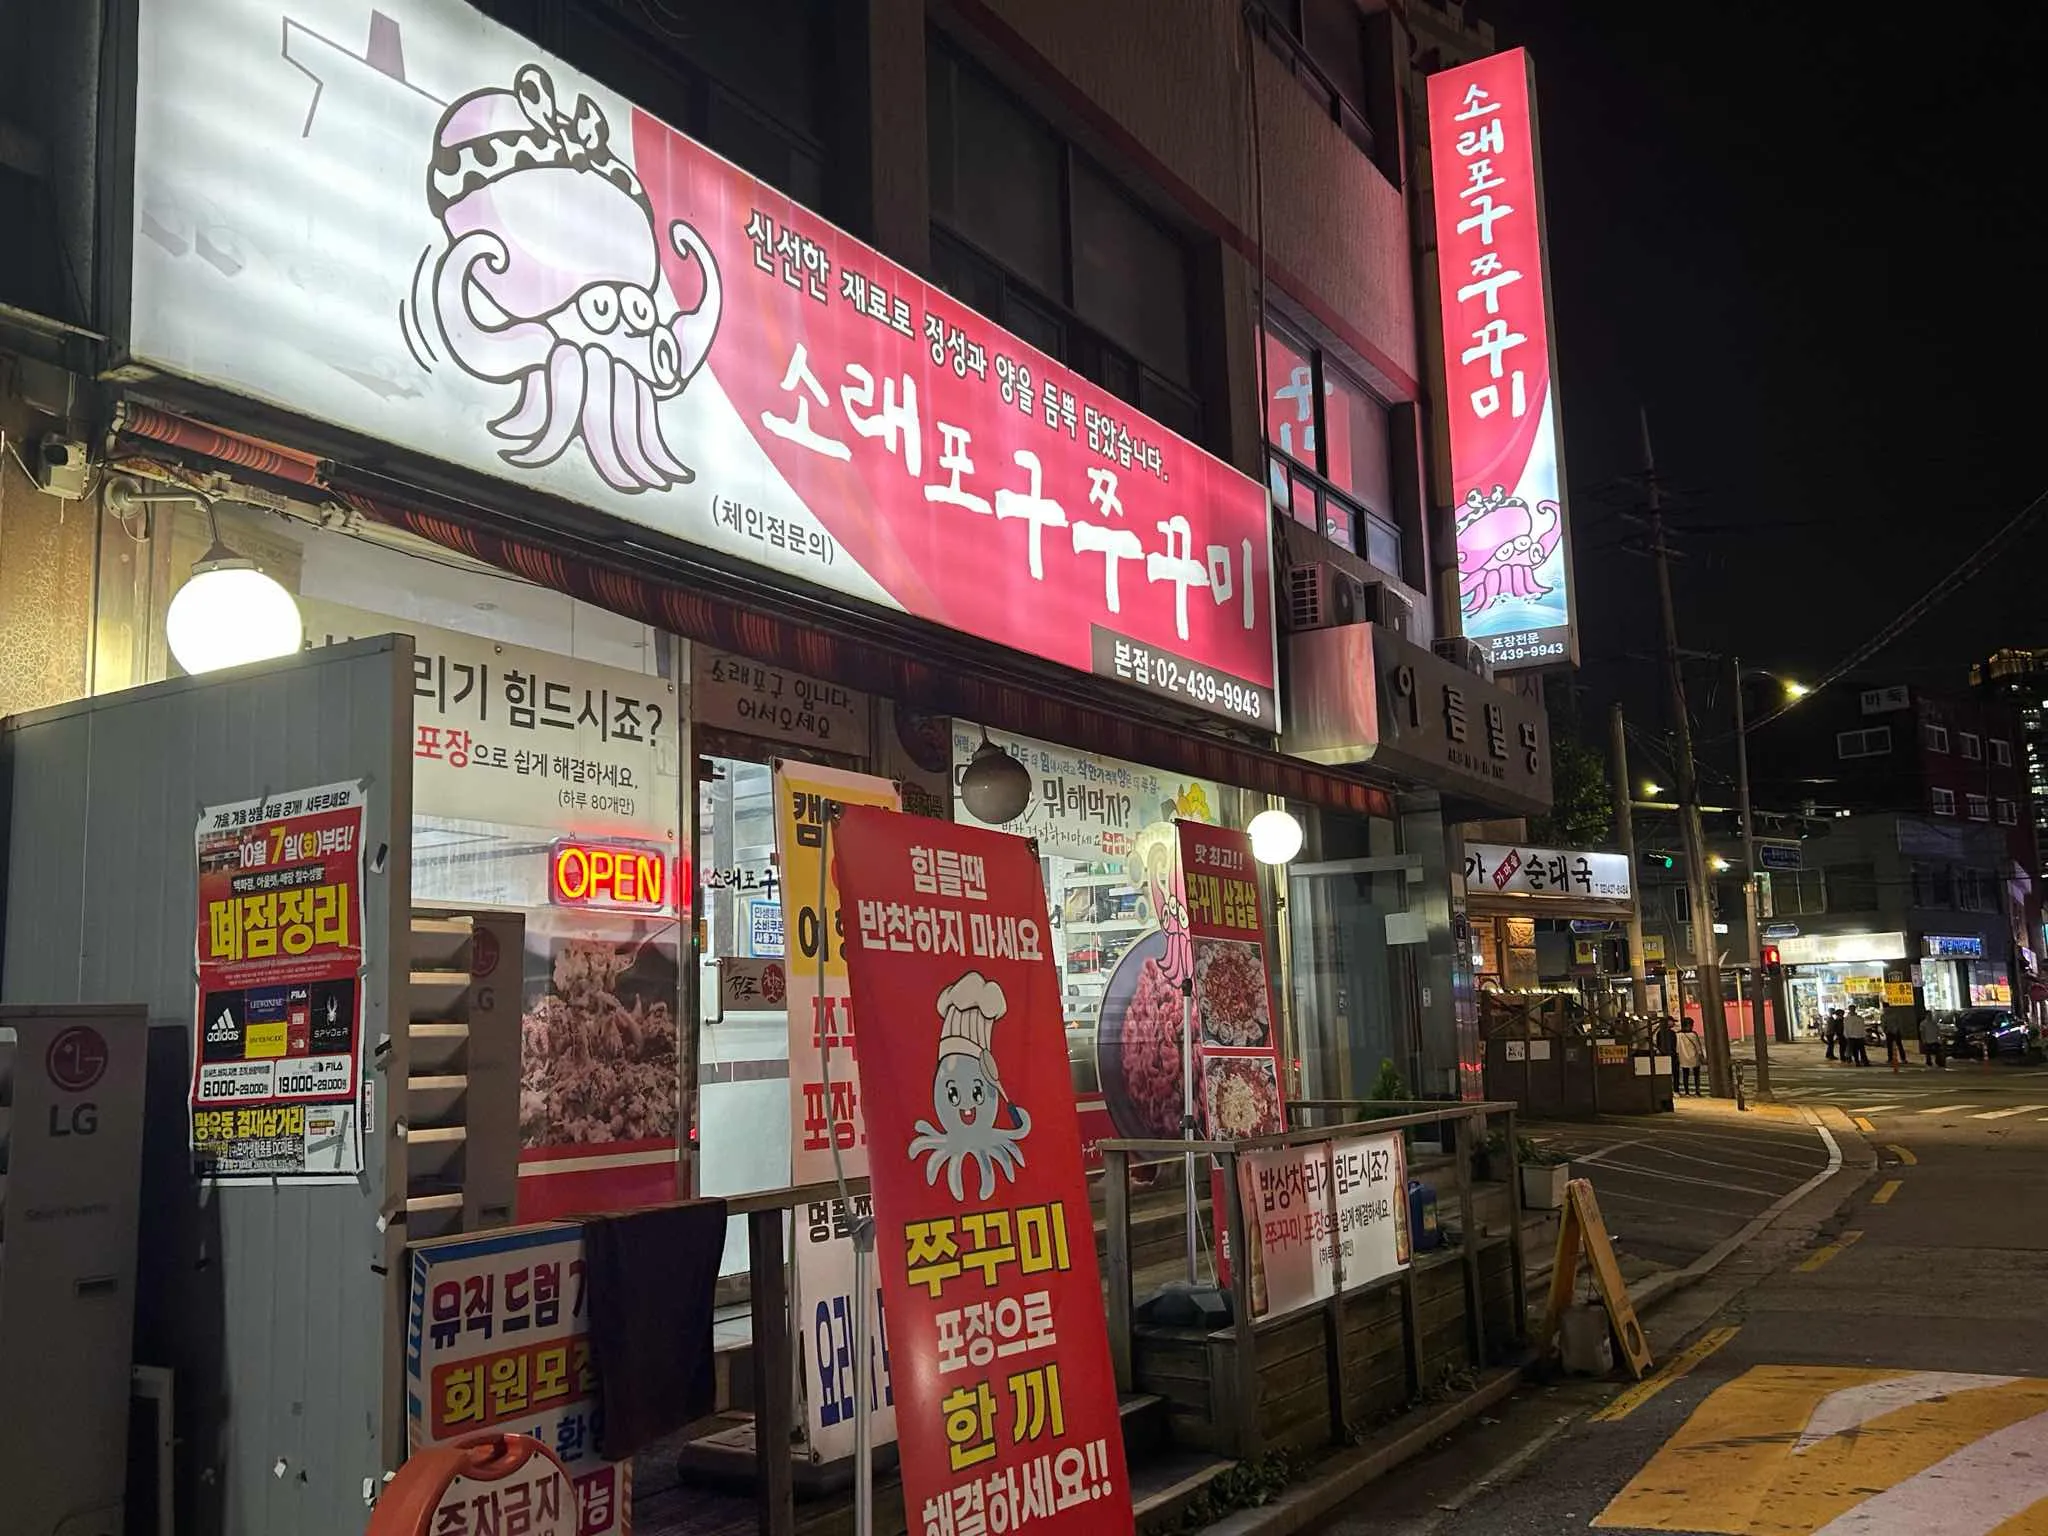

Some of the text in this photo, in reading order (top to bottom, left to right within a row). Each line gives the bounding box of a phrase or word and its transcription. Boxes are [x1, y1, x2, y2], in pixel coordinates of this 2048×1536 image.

[745, 209, 1169, 482] 신선한 재료로 정성과 양을 듬뿍 담았습니다.
[711, 494, 834, 566] (체인점문의)
[1491, 632, 1540, 649] 포장전문
[504, 669, 663, 747] 힘드시죠?
[711, 658, 854, 714] 소래포구 입니다.
[1113, 639, 1261, 721] 본점:02-439-9943
[737, 698, 831, 739] 어서오세요
[415, 725, 639, 790] 포장으로 쉽게 해결하세요.
[558, 789, 635, 817] (하루 80개만)
[793, 792, 824, 848] 캠
[1042, 777, 1131, 829] 뭐해먹지?
[239, 840, 267, 868] 10월
[558, 847, 662, 903] OPEN
[909, 845, 988, 901] 힘들땐
[1523, 853, 1593, 894] 순대국
[708, 867, 778, 901] 소래포구
[1186, 872, 1259, 931] 쭈꾸미 삼겹살
[209, 883, 349, 961] 폐점정리
[858, 899, 1043, 961] 반찬하지 마세요
[207, 1029, 239, 1042] adidas
[50, 1102, 97, 1138] LG
[194, 1110, 235, 1142] 망우동
[1335, 1149, 1389, 1195] 힘드시죠?
[904, 1202, 1072, 1298] 쭈꾸미
[1264, 1216, 1302, 1255] 쭈꾸미
[431, 1274, 494, 1350] 뮤직
[503, 1261, 560, 1334] 드럼
[935, 1290, 1057, 1374] 포장으로
[942, 1364, 1065, 1472] 한 끼
[922, 1439, 1113, 1536] 해결하세요!!
